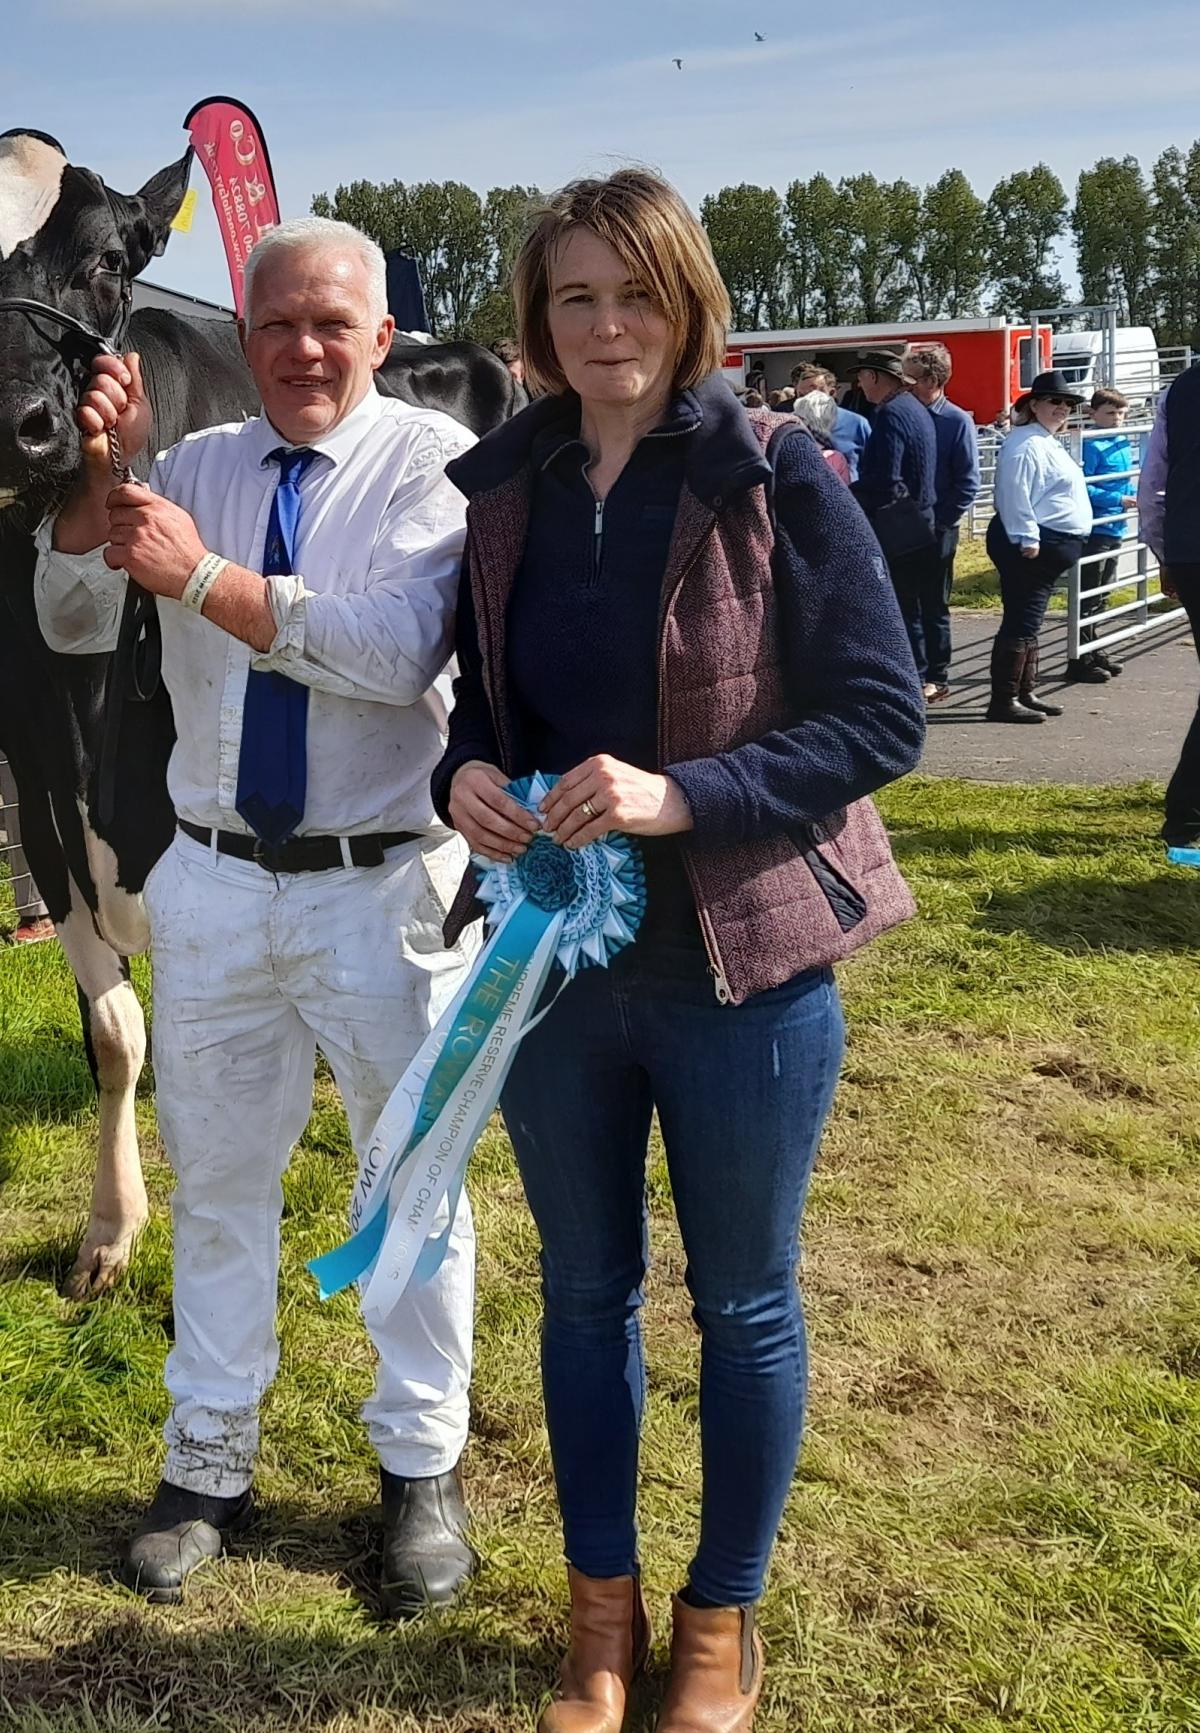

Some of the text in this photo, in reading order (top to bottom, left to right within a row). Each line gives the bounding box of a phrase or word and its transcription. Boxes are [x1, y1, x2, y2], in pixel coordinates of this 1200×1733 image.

[472, 957, 520, 1014] THE
[474, 1024, 509, 1097] RESERVE
[436, 1095, 474, 1169] CHAMPION
[425, 1160, 443, 1191] OF
